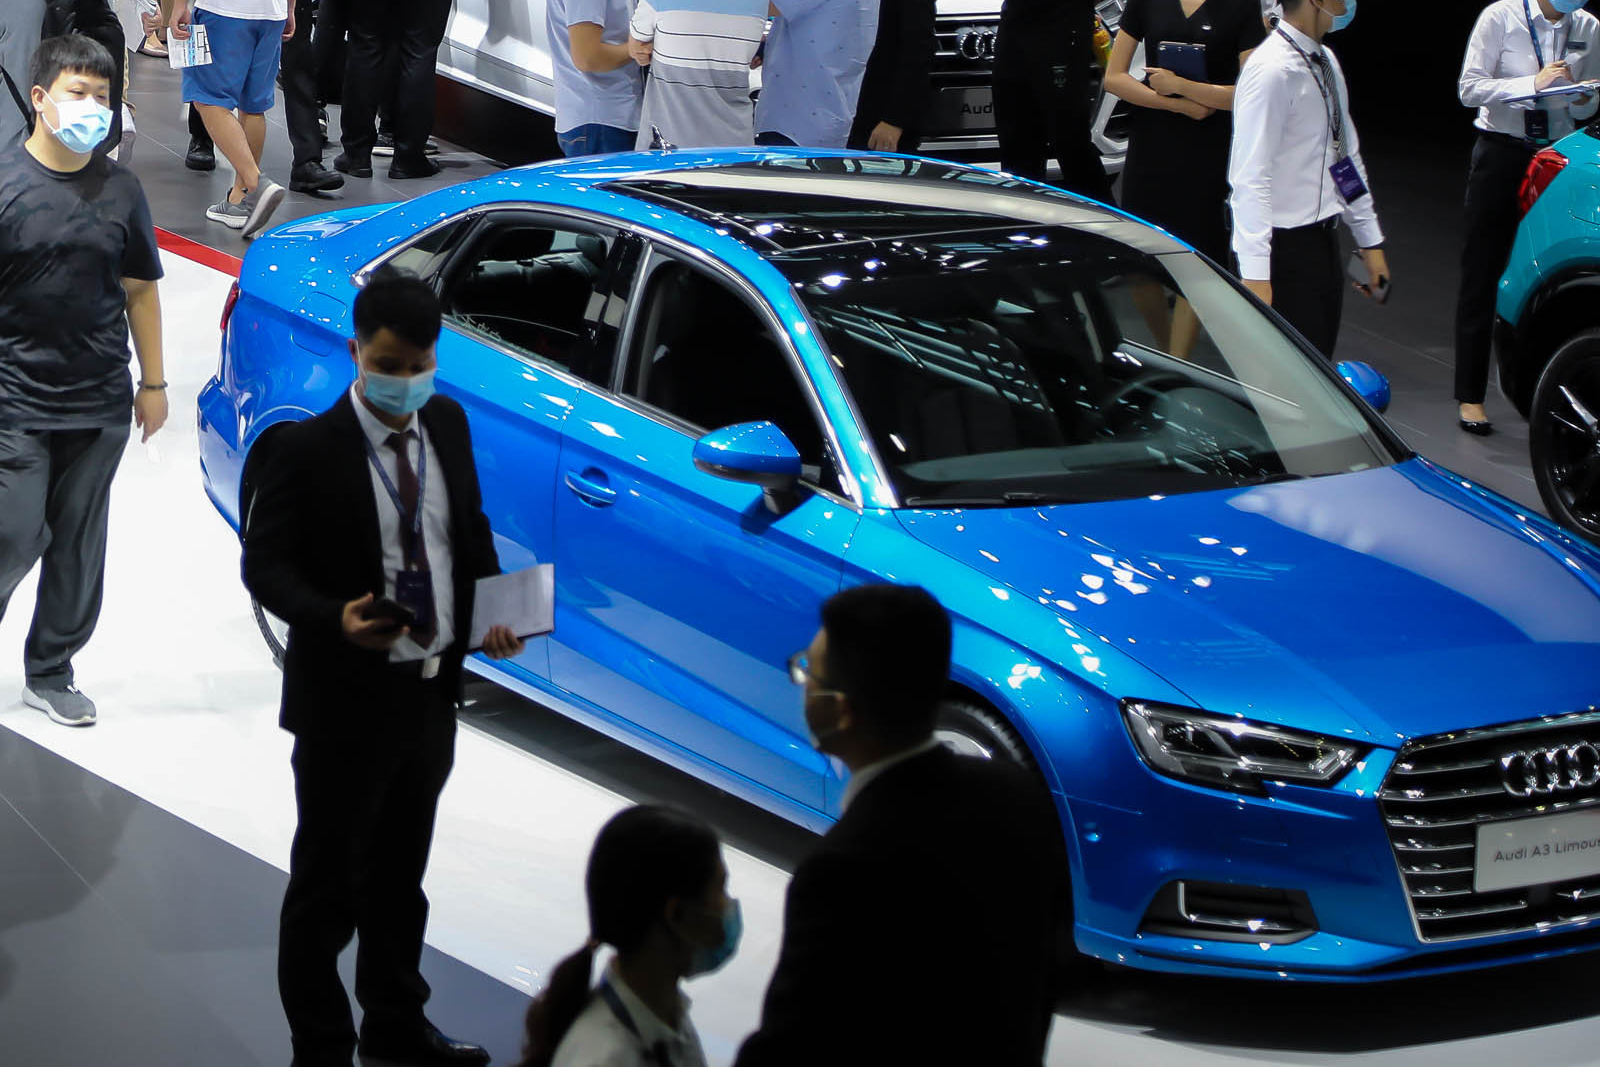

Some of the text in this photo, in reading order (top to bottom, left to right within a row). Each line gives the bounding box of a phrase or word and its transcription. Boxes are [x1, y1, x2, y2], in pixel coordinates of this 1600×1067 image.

[961, 102, 993, 115] Aud
[1494, 845, 1527, 862] Audi
[1532, 843, 1551, 857] A3
